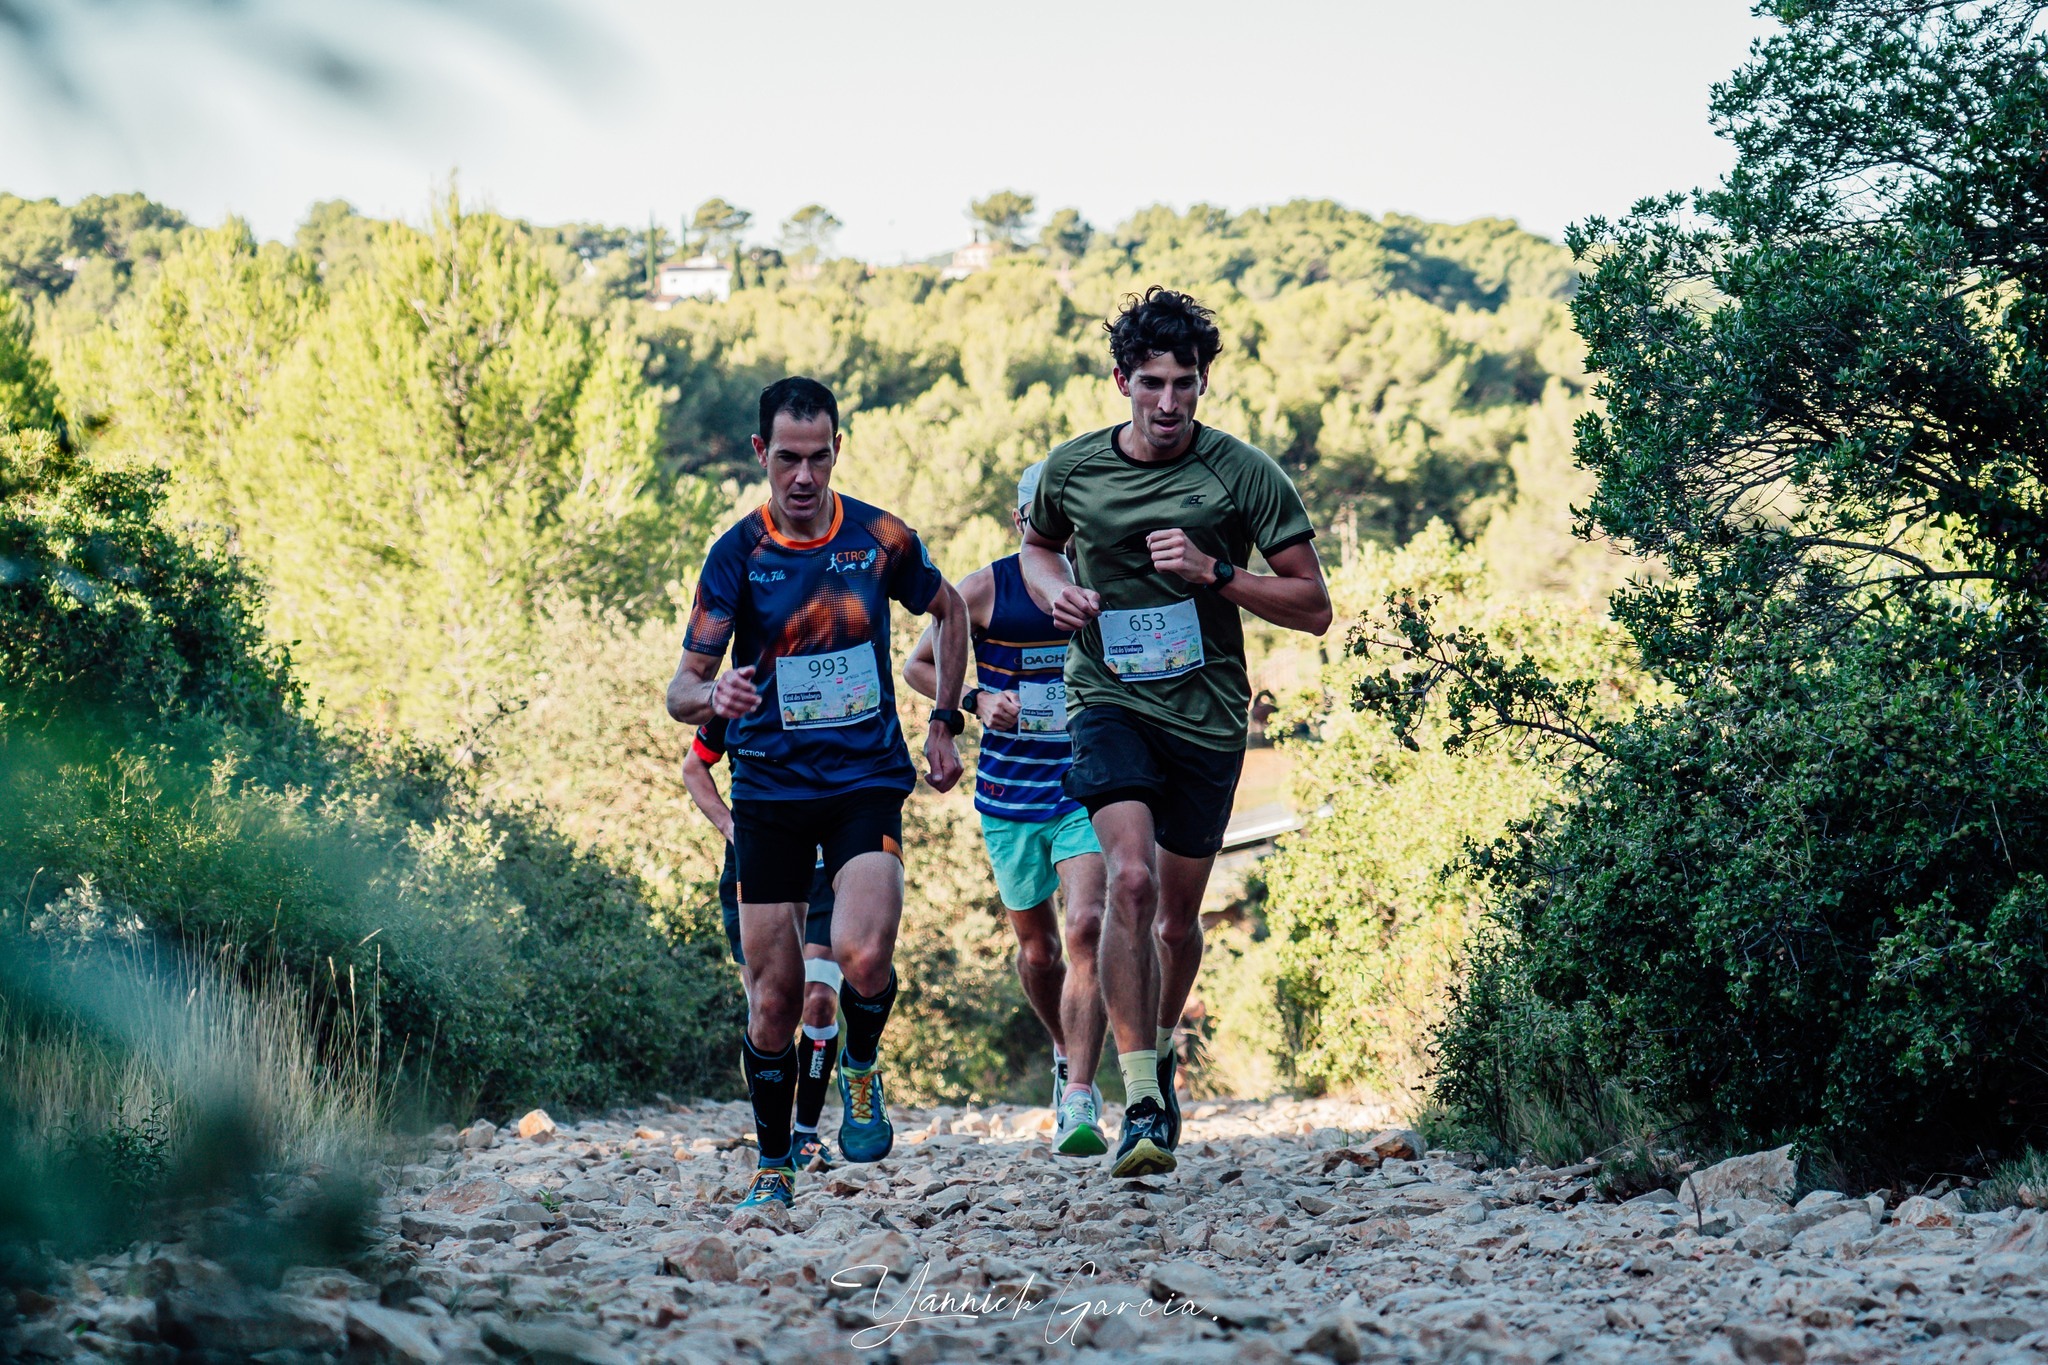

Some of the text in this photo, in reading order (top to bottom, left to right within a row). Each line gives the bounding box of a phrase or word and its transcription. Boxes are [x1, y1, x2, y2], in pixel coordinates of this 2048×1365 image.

[1129, 612, 1166, 632] 653
[808, 656, 849, 679] 993
[737, 748, 766, 758] SECTION
